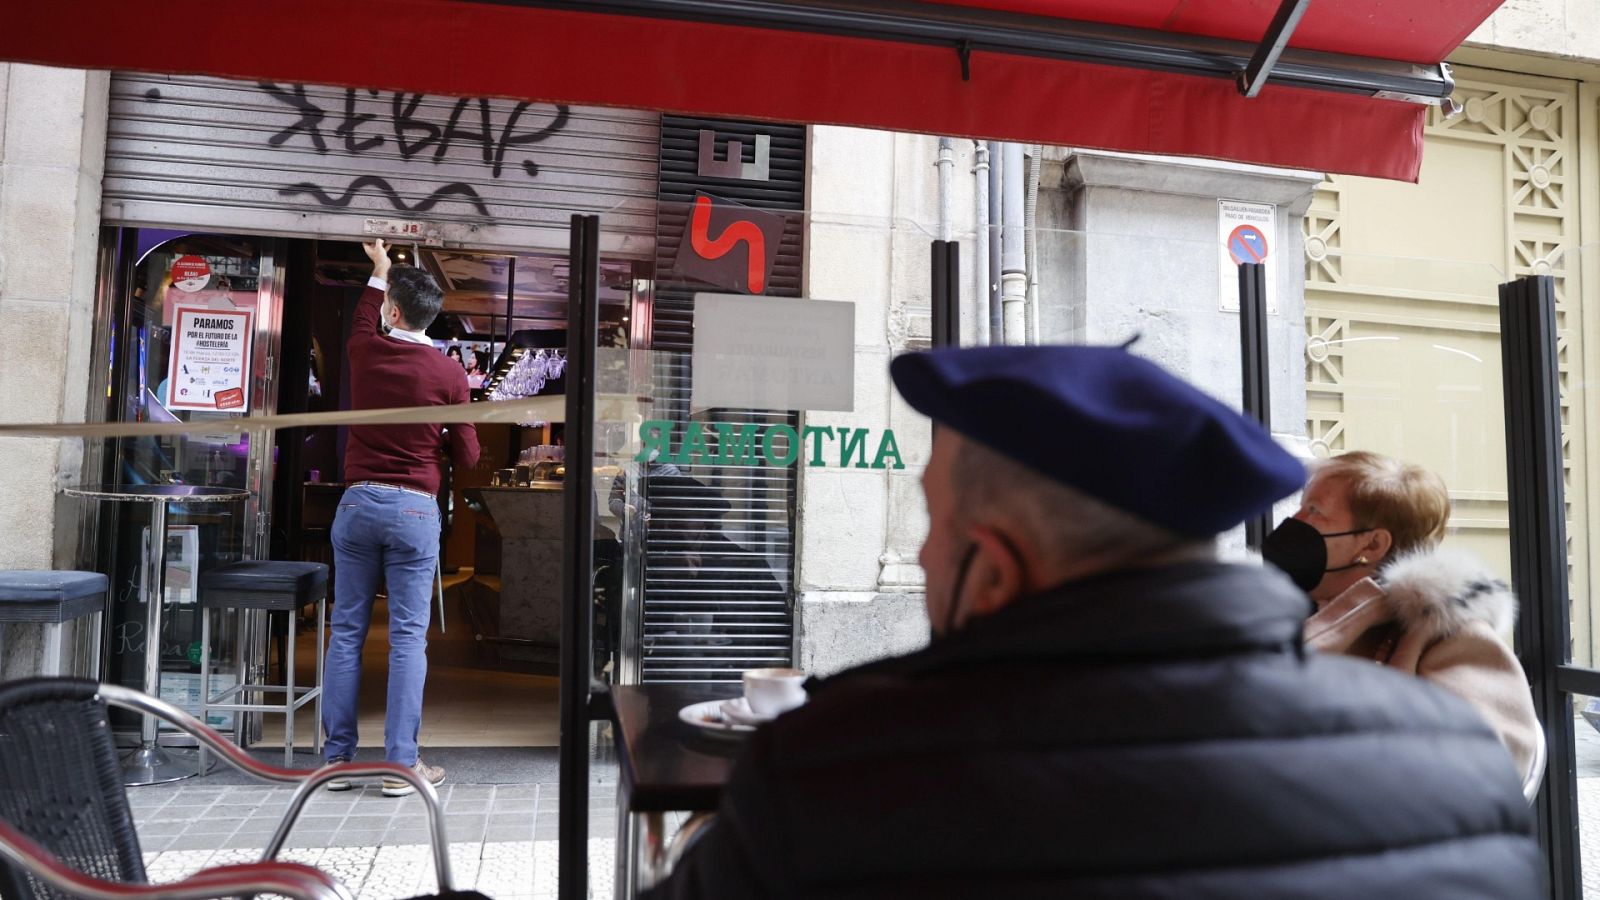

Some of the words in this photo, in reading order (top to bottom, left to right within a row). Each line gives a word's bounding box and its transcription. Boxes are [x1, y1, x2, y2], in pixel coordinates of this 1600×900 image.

[193, 317, 234, 330] PARAMOS
[187, 331, 198, 339] POR
[199, 331, 205, 339] EL
[205, 332, 225, 340] FUTURO
[231, 333, 238, 341] LA
[196, 340, 228, 348] #HOSTELERÍA
